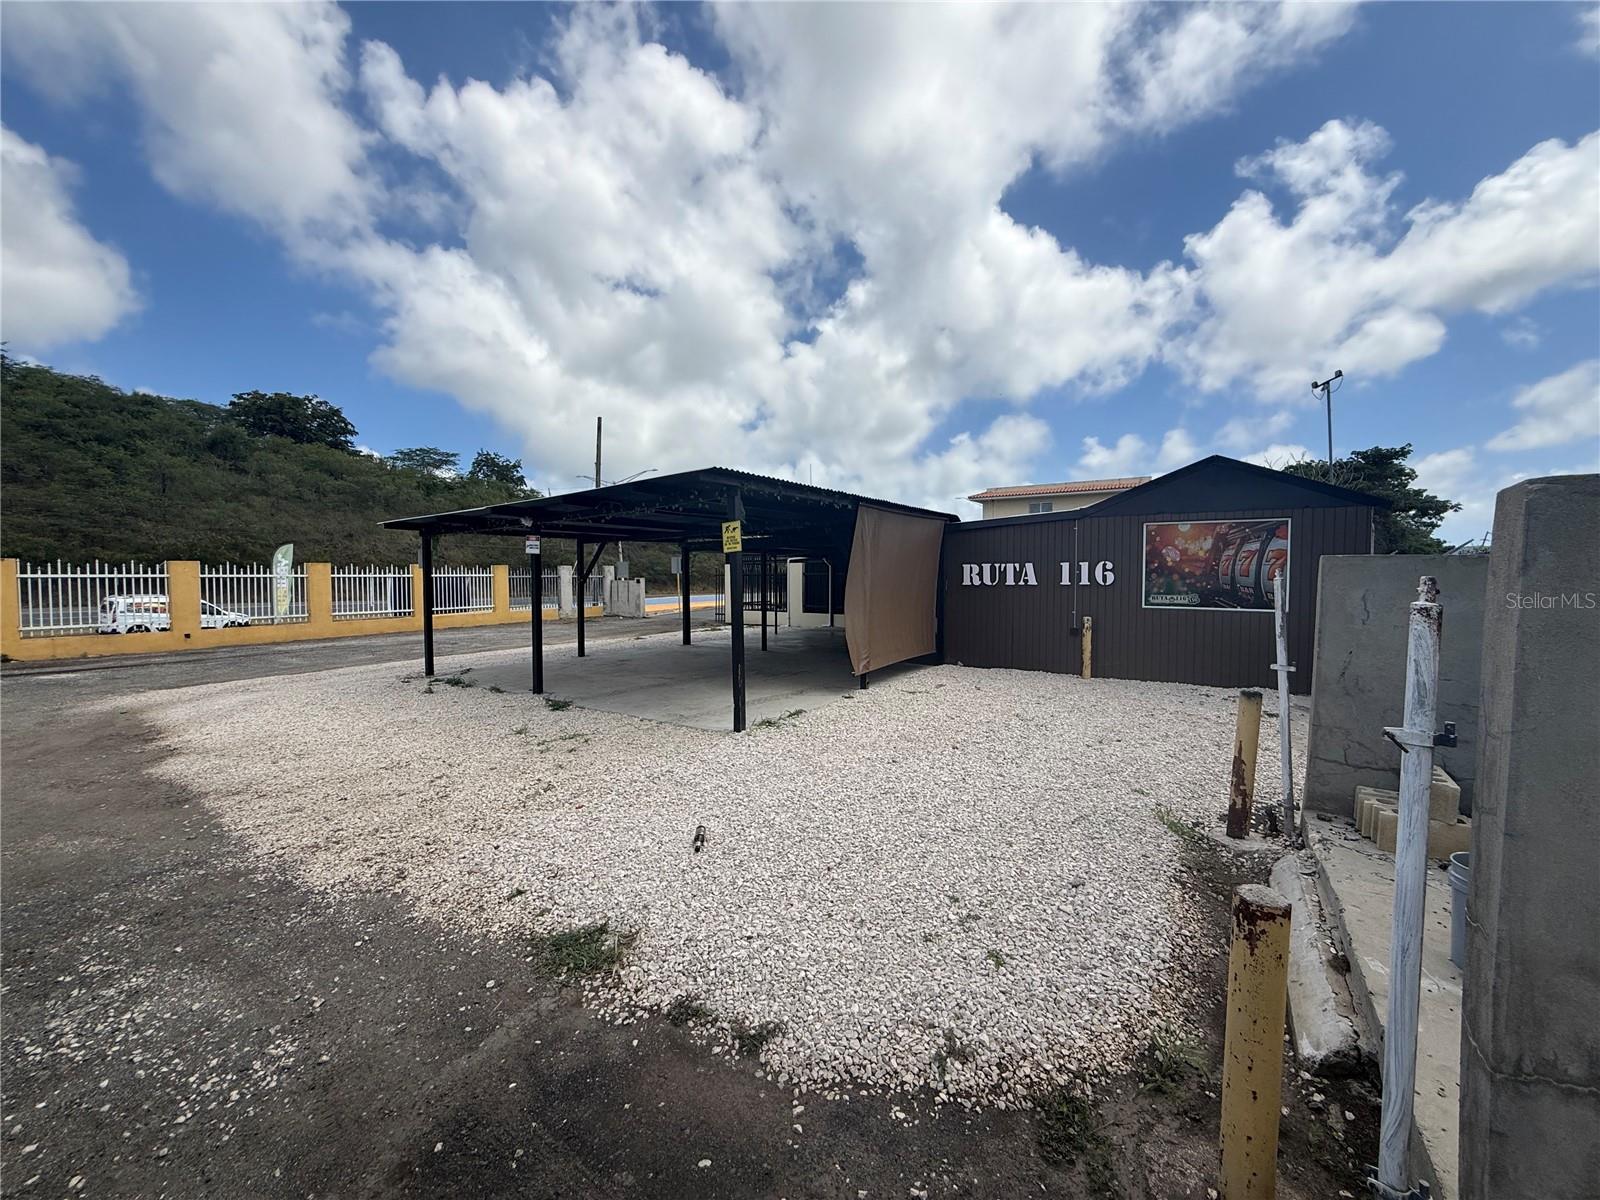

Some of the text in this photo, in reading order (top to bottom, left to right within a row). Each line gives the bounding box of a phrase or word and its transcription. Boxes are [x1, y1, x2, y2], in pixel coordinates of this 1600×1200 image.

[961, 560, 1115, 586] RUTA 116
[1238, 549, 1258, 577] 7
[1265, 548, 1287, 582] 7
